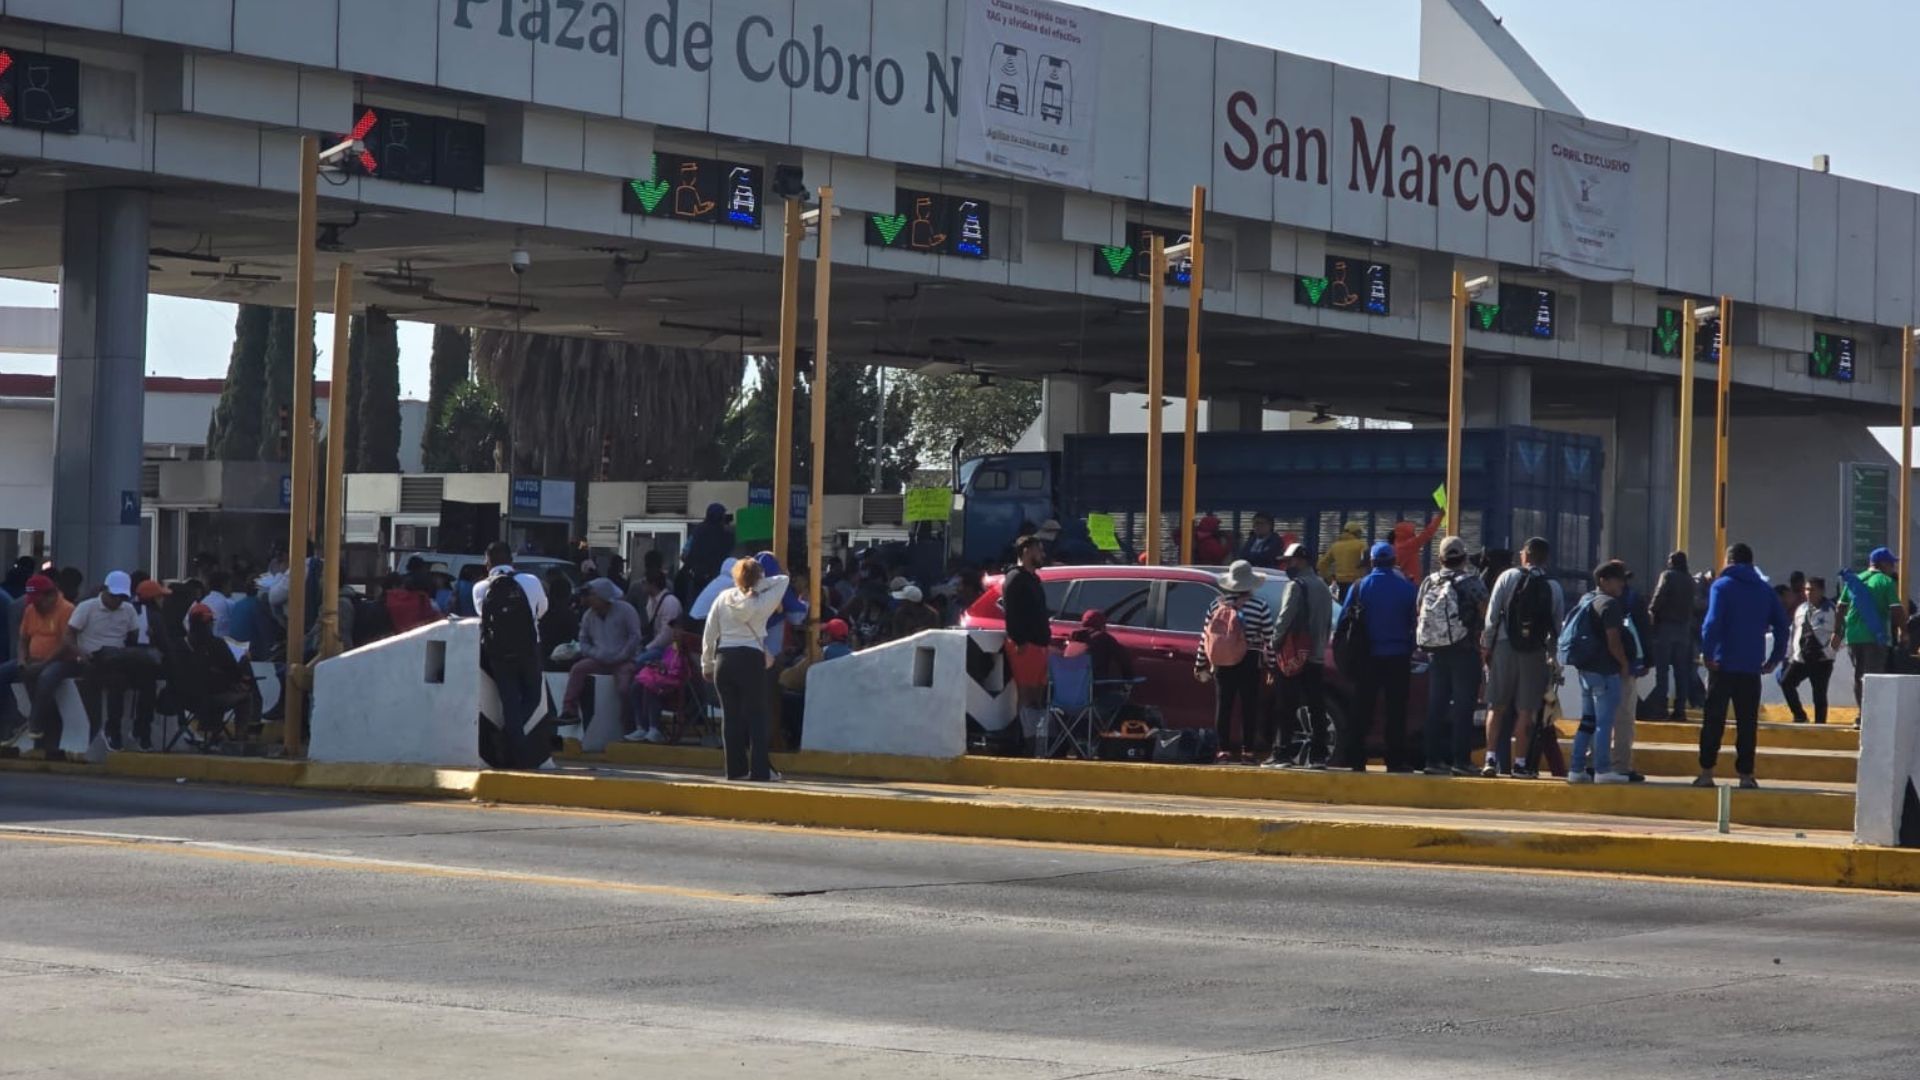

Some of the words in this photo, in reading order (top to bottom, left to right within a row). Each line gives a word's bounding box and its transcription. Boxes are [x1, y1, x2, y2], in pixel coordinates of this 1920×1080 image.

[645, 0, 713, 72] de
[737, 15, 904, 105] Cobro
[1223, 90, 1329, 186] San
[1348, 115, 1536, 224] Marcos
[1584, 153, 1630, 173] EXCLUSIVO
[515, 480, 538, 492] AUTOS
